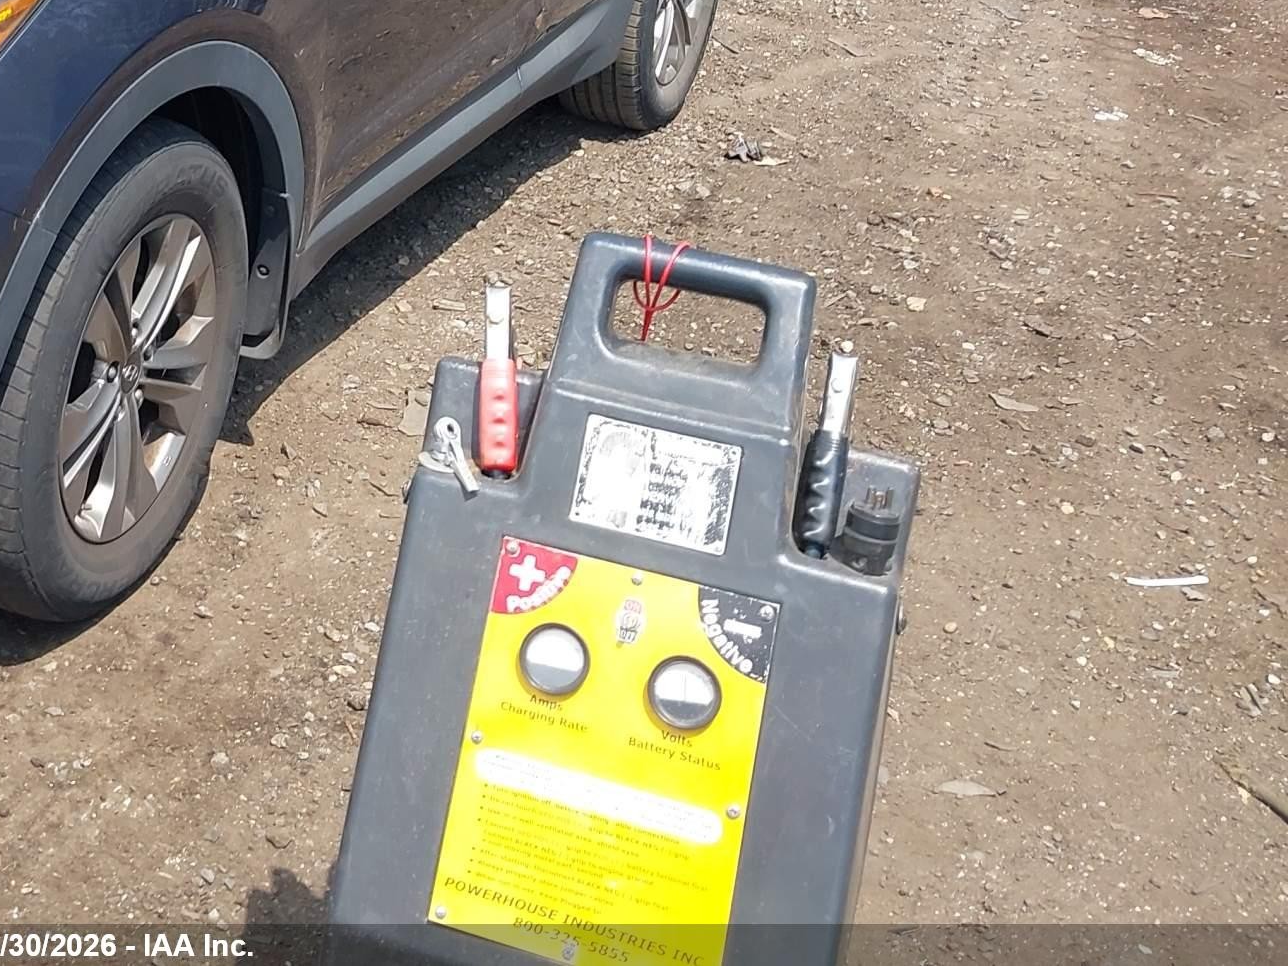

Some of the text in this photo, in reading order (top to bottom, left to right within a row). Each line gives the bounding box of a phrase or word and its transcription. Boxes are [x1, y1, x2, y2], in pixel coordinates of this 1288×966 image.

[701, 599, 753, 674] Negative
[500, 701, 589, 733] Charging Rate
[530, 694, 563, 712] Amps
[628, 737, 722, 772] Battery Status
[662, 730, 693, 748] Volts
[444, 876, 559, 921] POWERHOUSE
[562, 914, 668, 956] INDUSTRIES
[673, 949, 705, 966] INC
